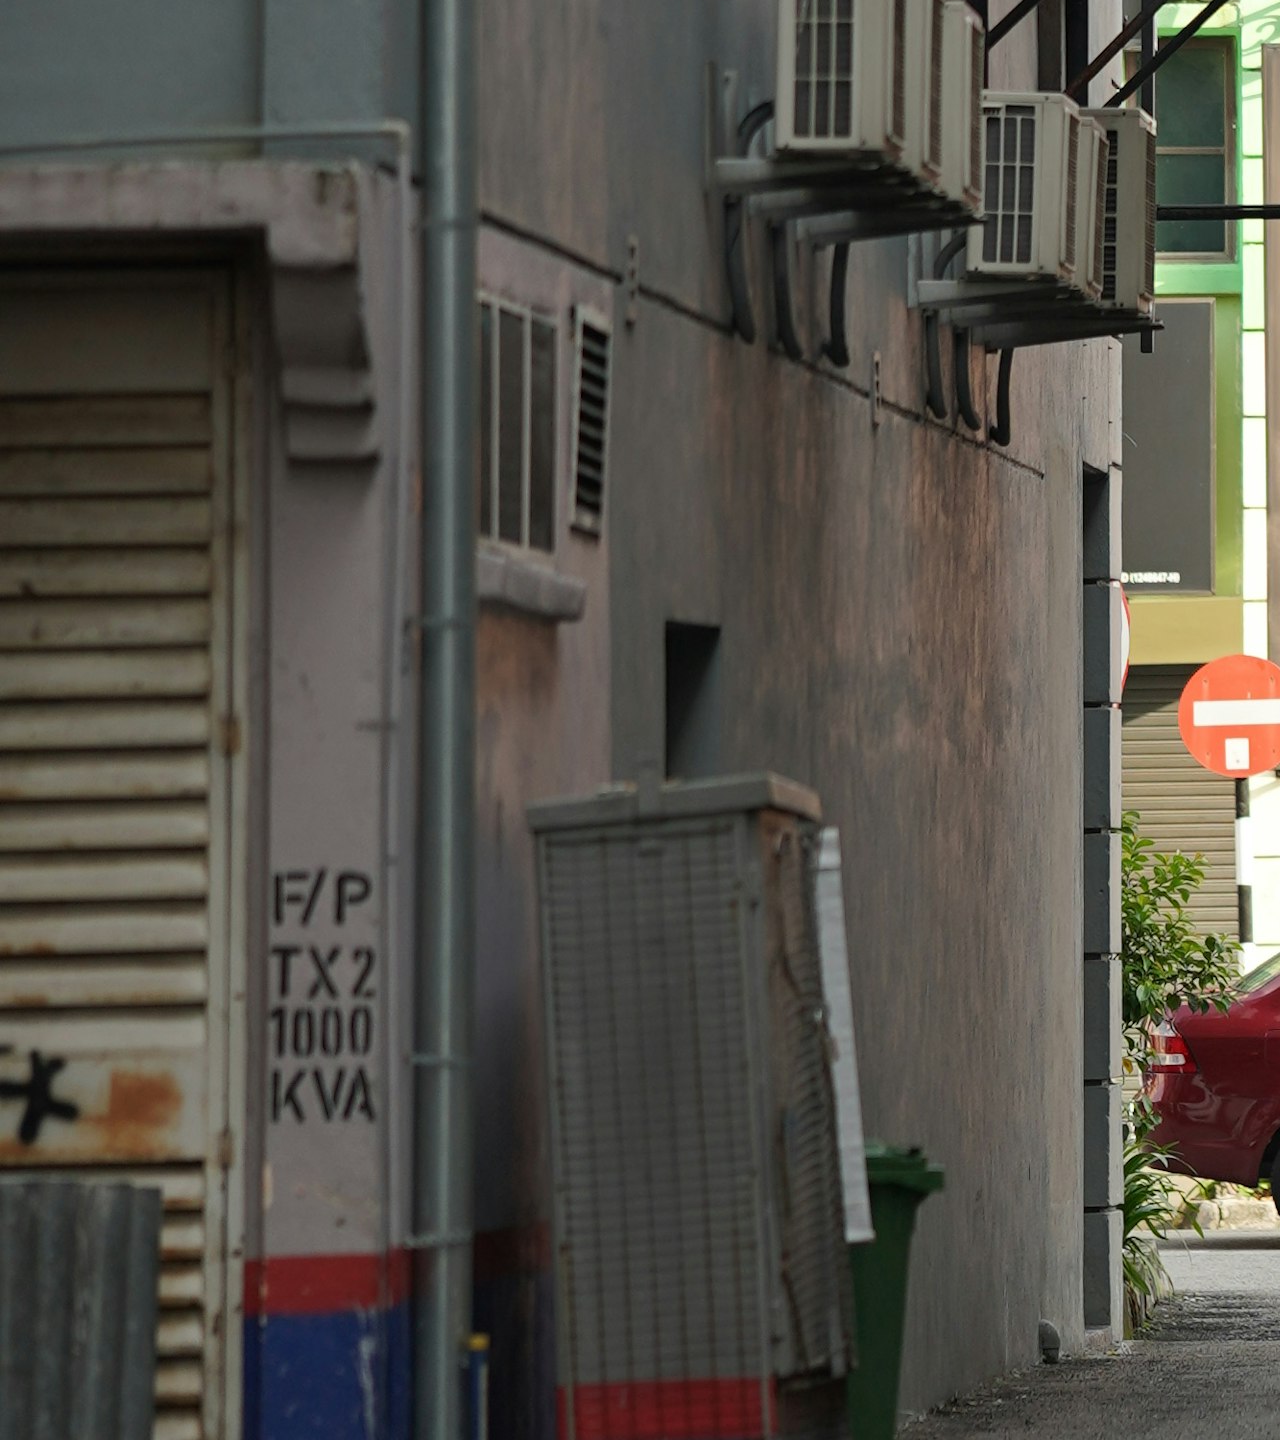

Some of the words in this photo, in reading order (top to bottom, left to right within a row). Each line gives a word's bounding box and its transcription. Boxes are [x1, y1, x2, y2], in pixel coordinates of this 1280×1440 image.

[273, 867, 372, 926] F/P
[271, 945, 376, 1000] TX2
[271, 1006, 372, 1058] 1000
[271, 1068, 376, 1123] KVA
